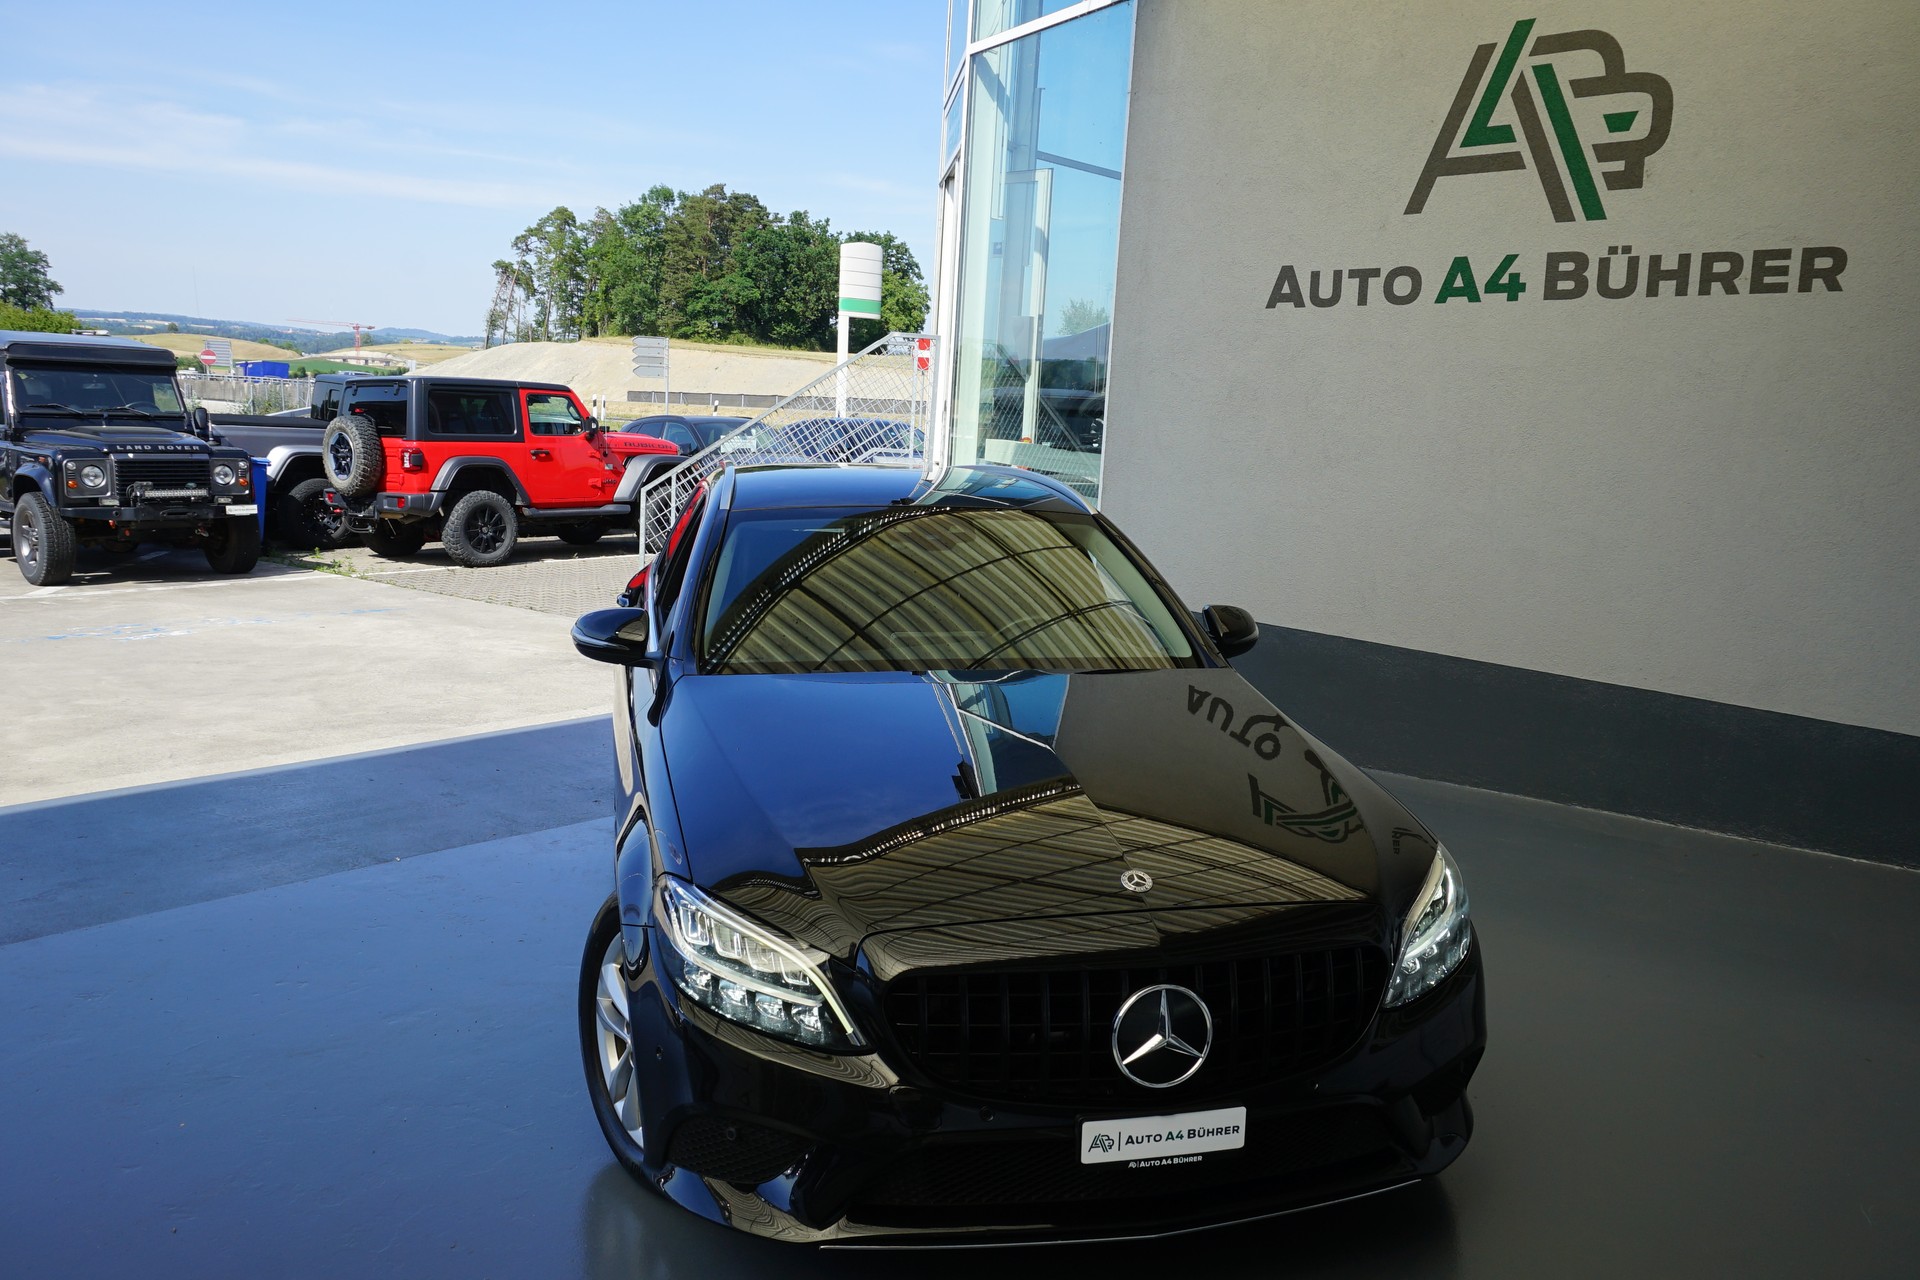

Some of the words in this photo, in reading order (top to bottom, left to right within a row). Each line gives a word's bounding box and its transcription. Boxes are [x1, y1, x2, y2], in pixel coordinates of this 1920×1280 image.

[1265, 265, 1423, 309] AUTO
[1434, 253, 1527, 304] A4
[1543, 245, 1850, 301] BÜHRER
[623, 441, 673, 449] RUBICON
[1125, 1134, 1163, 1146] AUTO
[1165, 1130, 1184, 1142] A4
[1187, 1125, 1240, 1140] BÜHRER
[1140, 1160, 1160, 1168] AUTO
[1161, 1158, 1172, 1166] A4
[1173, 1155, 1203, 1165] BÜHRER
